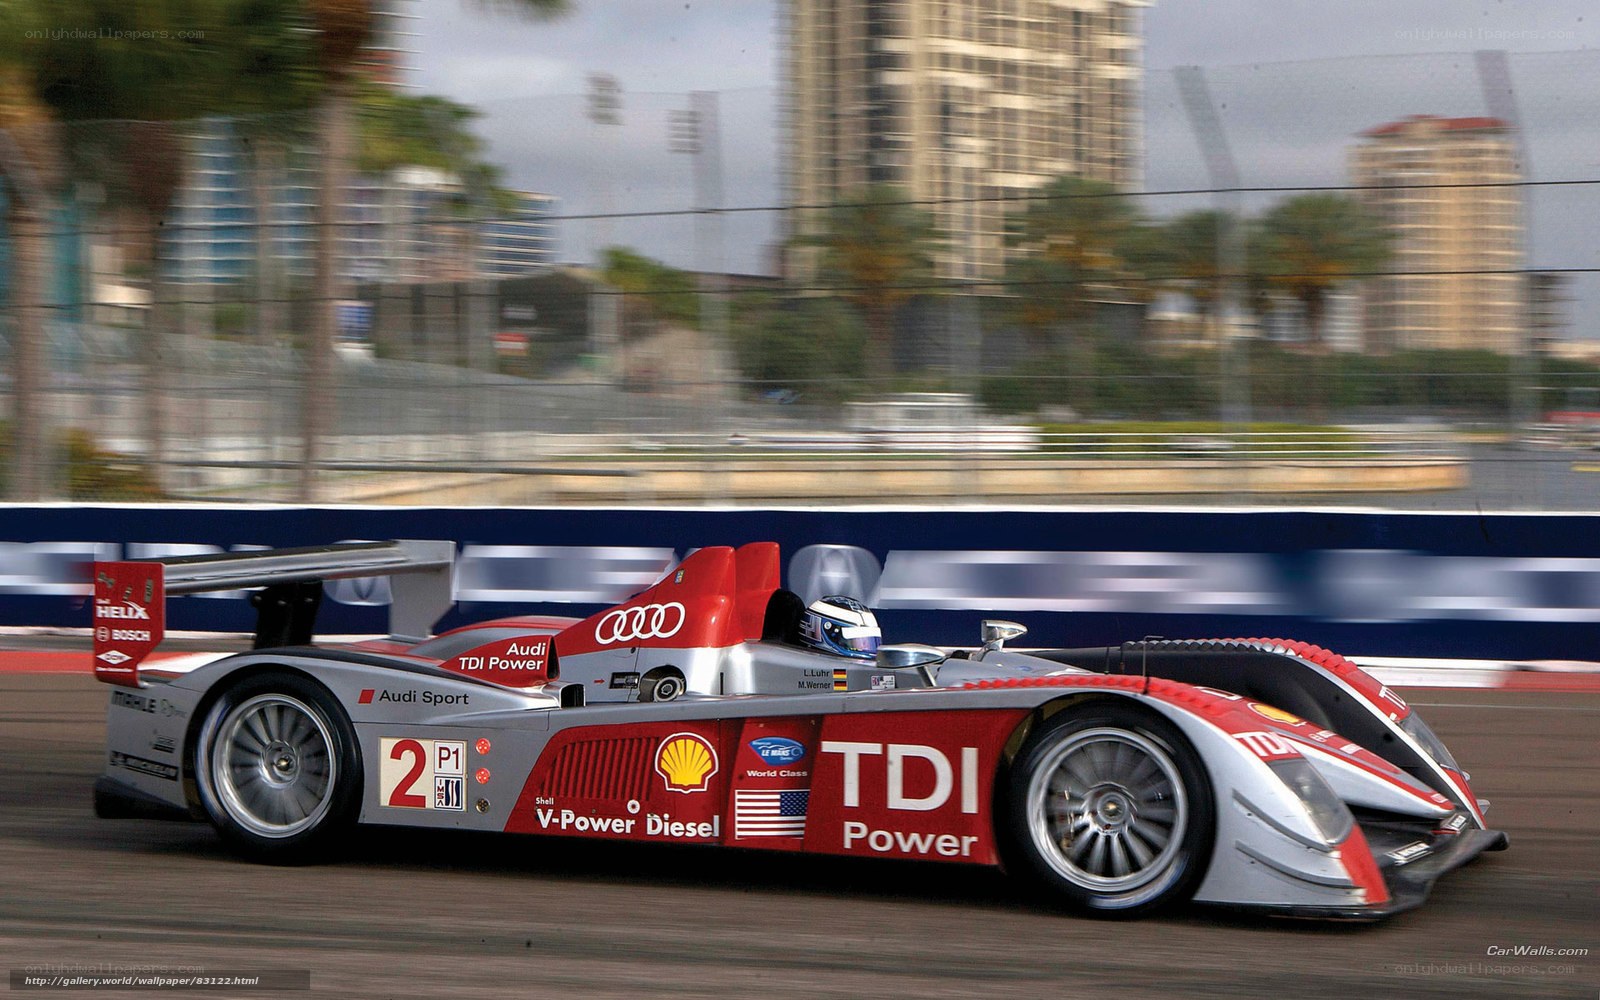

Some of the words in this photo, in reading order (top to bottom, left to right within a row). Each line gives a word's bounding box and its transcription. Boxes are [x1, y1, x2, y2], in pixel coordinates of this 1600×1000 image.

[95, 600, 150, 620] HELIX
[111, 629, 151, 642] BOSCH
[506, 642, 546, 656] Audi
[459, 656, 484, 670] TDI
[488, 656, 543, 671] Power
[803, 669, 829, 677] L.Luhr
[797, 681, 831, 689] M.Werner
[378, 689, 417, 703] Audi
[422, 691, 469, 706] Sport
[1231, 731, 1299, 757] TDI
[438, 746, 459, 770] P1
[761, 749, 770, 757] LE
[388, 739, 427, 808] 2
[746, 769, 777, 777] World
[821, 741, 979, 814] TDI
[535, 797, 554, 805] Shell
[537, 808, 636, 834] V-Power
[646, 813, 720, 838] Diesel
[843, 821, 979, 857] Power
